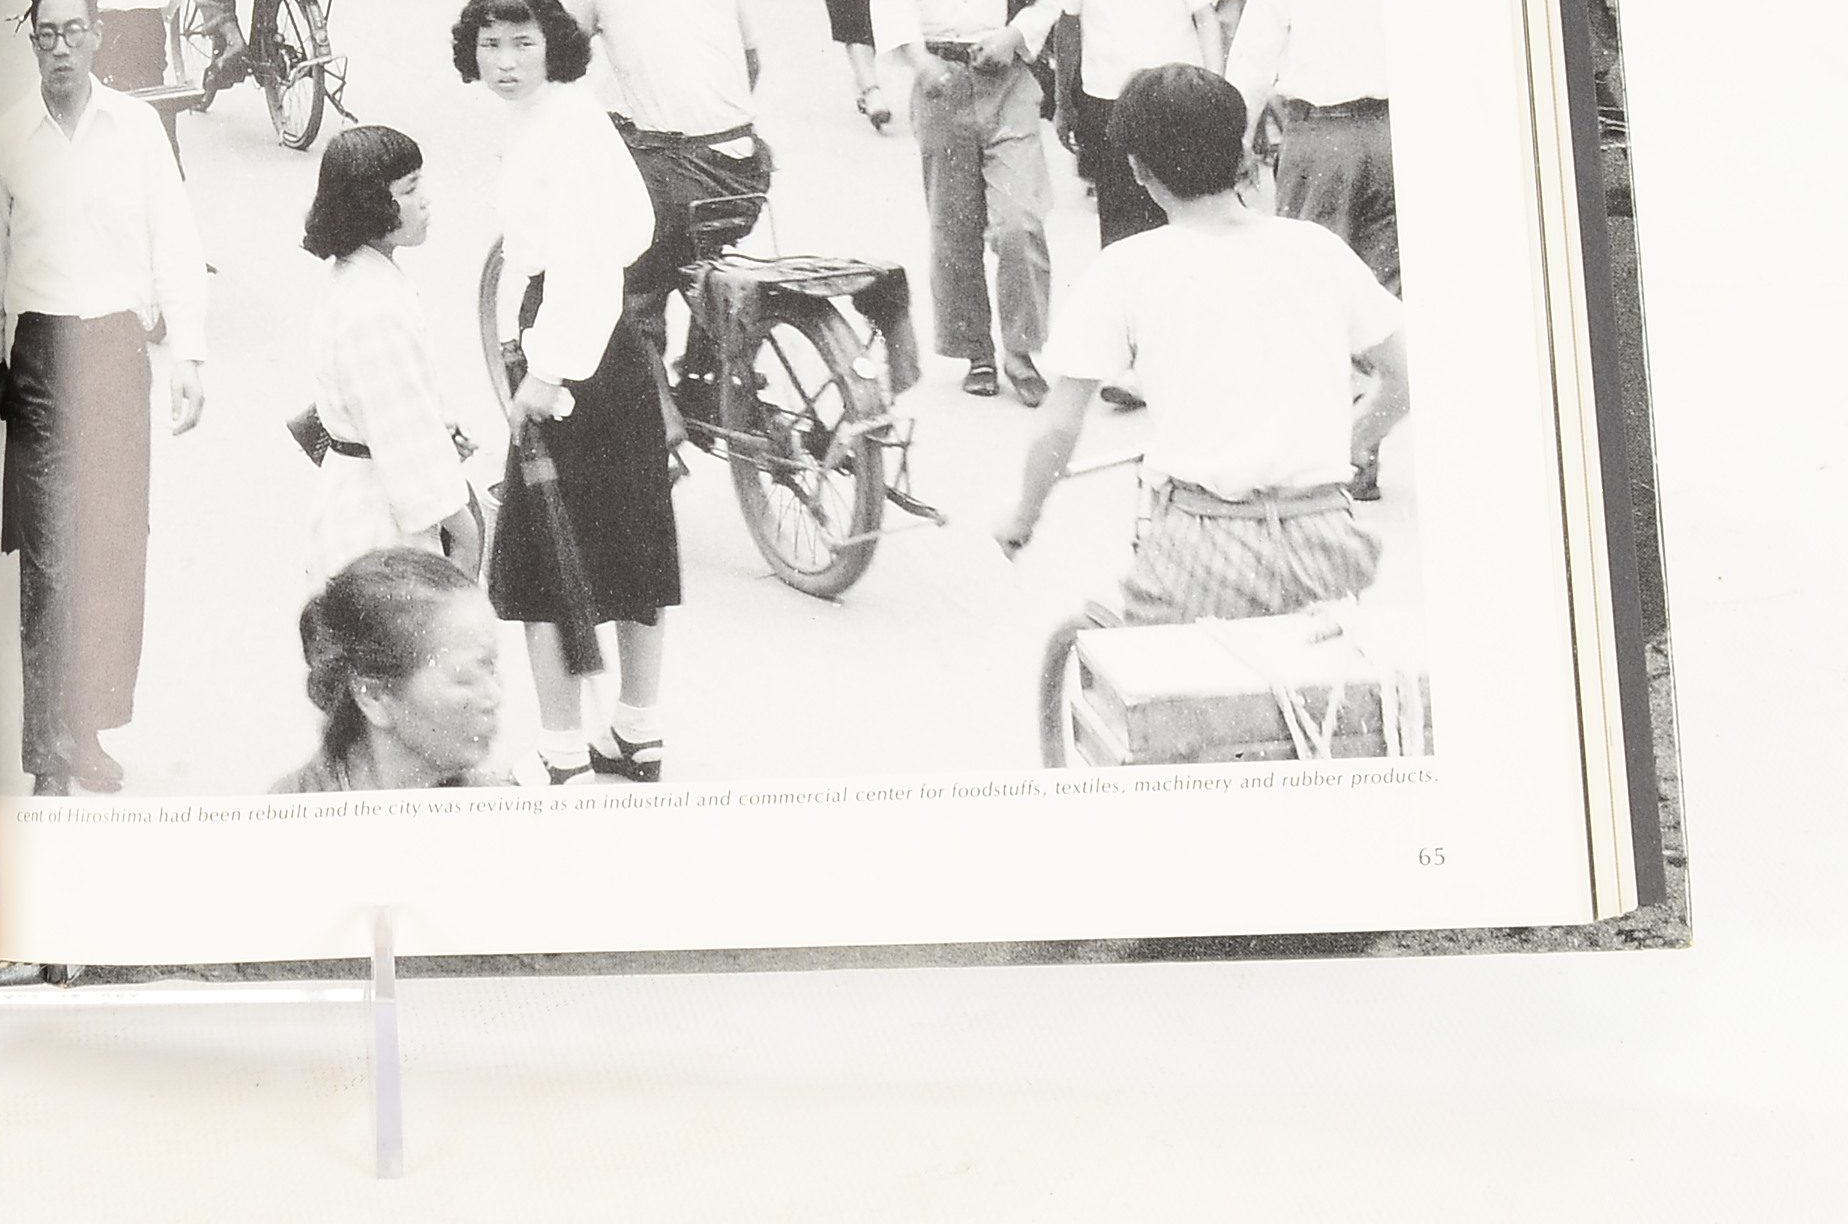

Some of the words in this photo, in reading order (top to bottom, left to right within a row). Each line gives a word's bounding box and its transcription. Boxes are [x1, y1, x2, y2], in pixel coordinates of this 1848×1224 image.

[16, 808, 43, 823] cent
[48, 806, 62, 823] of
[66, 806, 152, 824] Hiroshima
[158, 805, 191, 824] had
[198, 806, 242, 823] been
[248, 801, 308, 821] rebuilt
[314, 800, 347, 819] and
[354, 799, 382, 817] the
[388, 799, 421, 819] city
[428, 801, 461, 815] was
[468, 795, 543, 815] reviving
[549, 797, 568, 812] as
[574, 795, 596, 811] an
[603, 792, 690, 810] industrial
[696, 790, 731, 807] and
[738, 786, 847, 807] commercial
[854, 785, 913, 803] center
[919, 782, 944, 800] for
[952, 779, 1048, 798] foodstuffs,
[1055, 777, 1126, 796] textiles,
[1134, 773, 1233, 794] machinery
[1239, 772, 1274, 790] and
[1281, 770, 1344, 788] rubber
[1351, 767, 1439, 789] products.
[1418, 847, 1446, 867] 65
